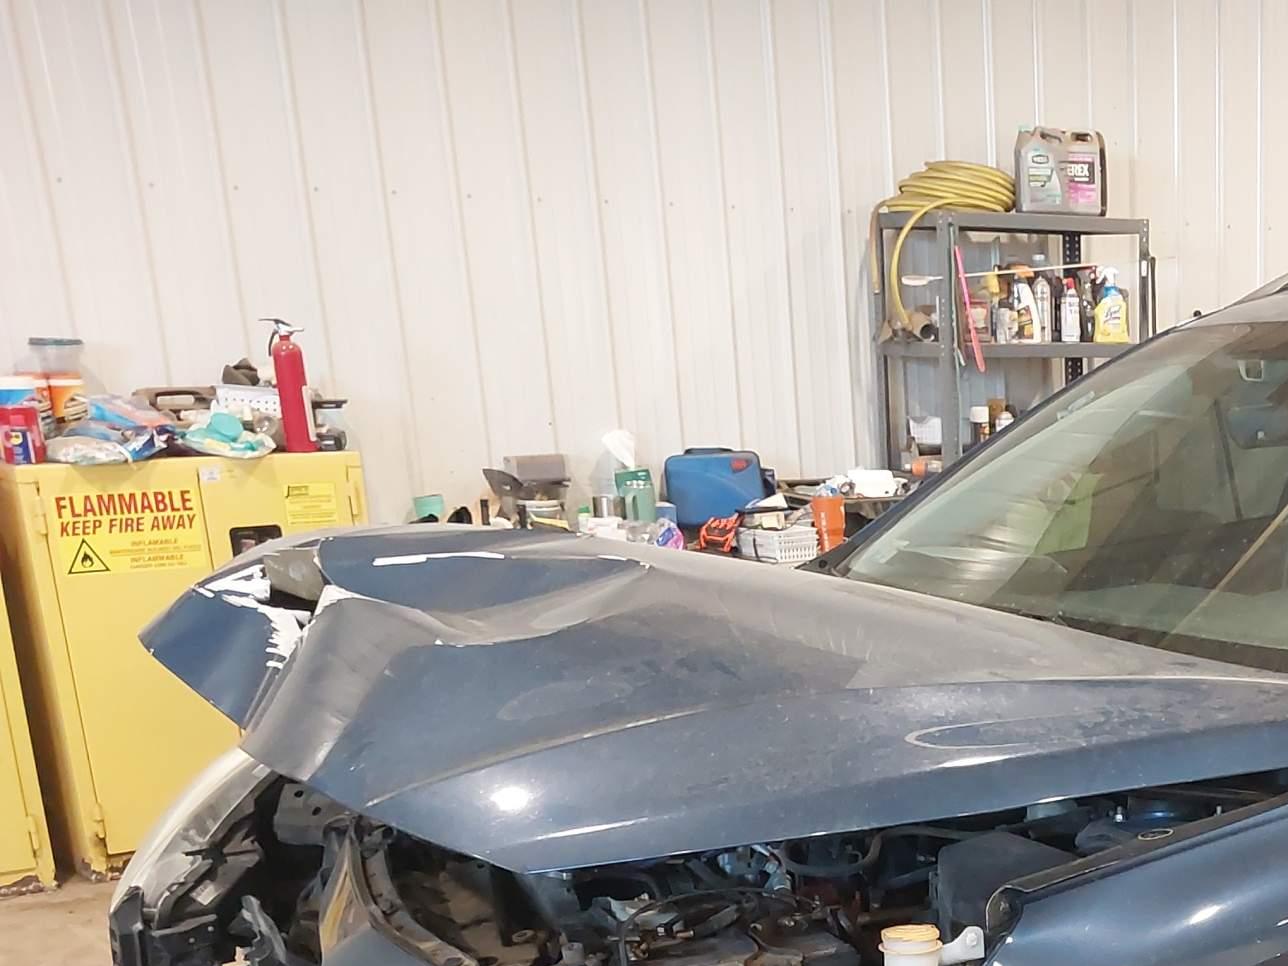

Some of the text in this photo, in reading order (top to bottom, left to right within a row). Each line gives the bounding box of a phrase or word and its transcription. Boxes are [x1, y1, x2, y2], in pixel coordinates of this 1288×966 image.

[55, 490, 194, 519] FLAMMABLE
[60, 514, 196, 537] KEEP FIRE AWAY
